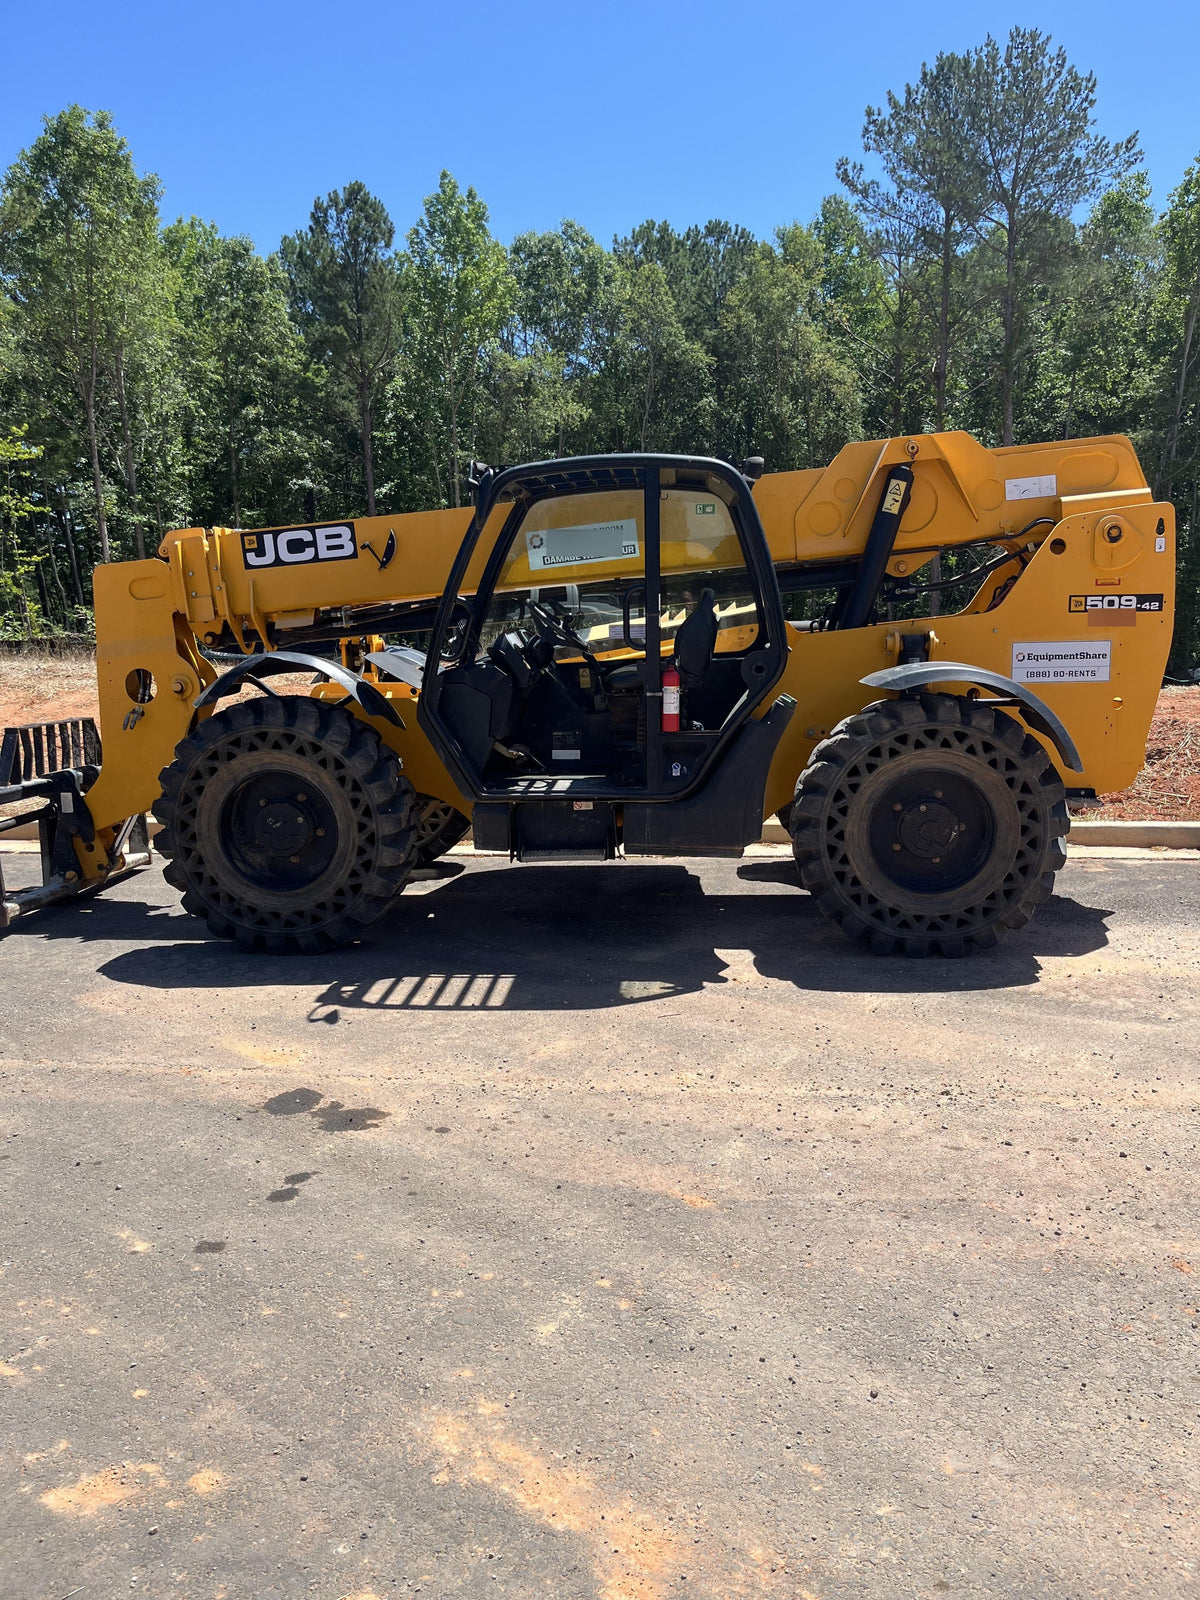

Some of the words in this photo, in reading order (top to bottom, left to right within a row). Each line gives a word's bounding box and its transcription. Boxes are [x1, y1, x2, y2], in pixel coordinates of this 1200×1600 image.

[246, 526, 355, 566] JCB
[1026, 651, 1108, 662] EquipmentShare
[1026, 670, 1051, 679] (888)
